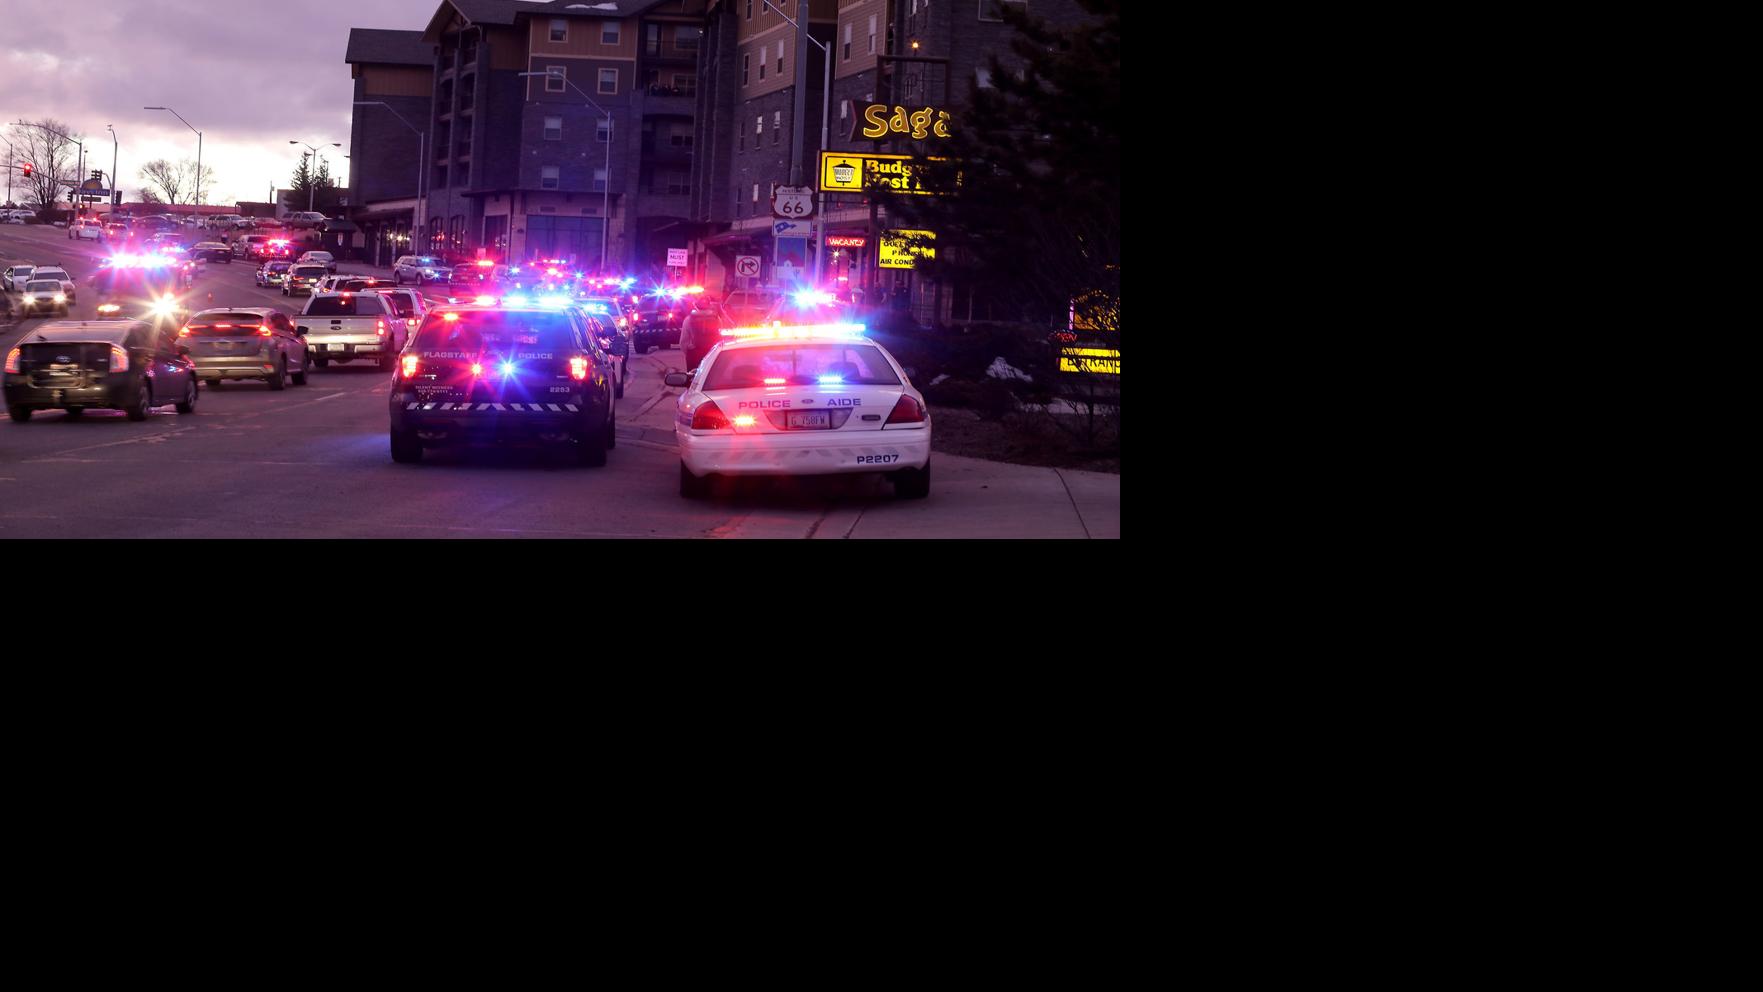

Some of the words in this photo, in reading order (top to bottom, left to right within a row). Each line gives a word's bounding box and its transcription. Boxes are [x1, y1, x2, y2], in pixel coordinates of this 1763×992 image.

[863, 104, 951, 139] Saga
[865, 159, 913, 177] Budg
[782, 201, 804, 214] 66
[829, 238, 864, 246] VACANCY
[423, 351, 478, 359] FLAGSTAFF
[518, 352, 553, 360] POLICE
[738, 399, 791, 409] POLICE
[826, 398, 862, 407] AIDE
[856, 454, 900, 464] P2207
